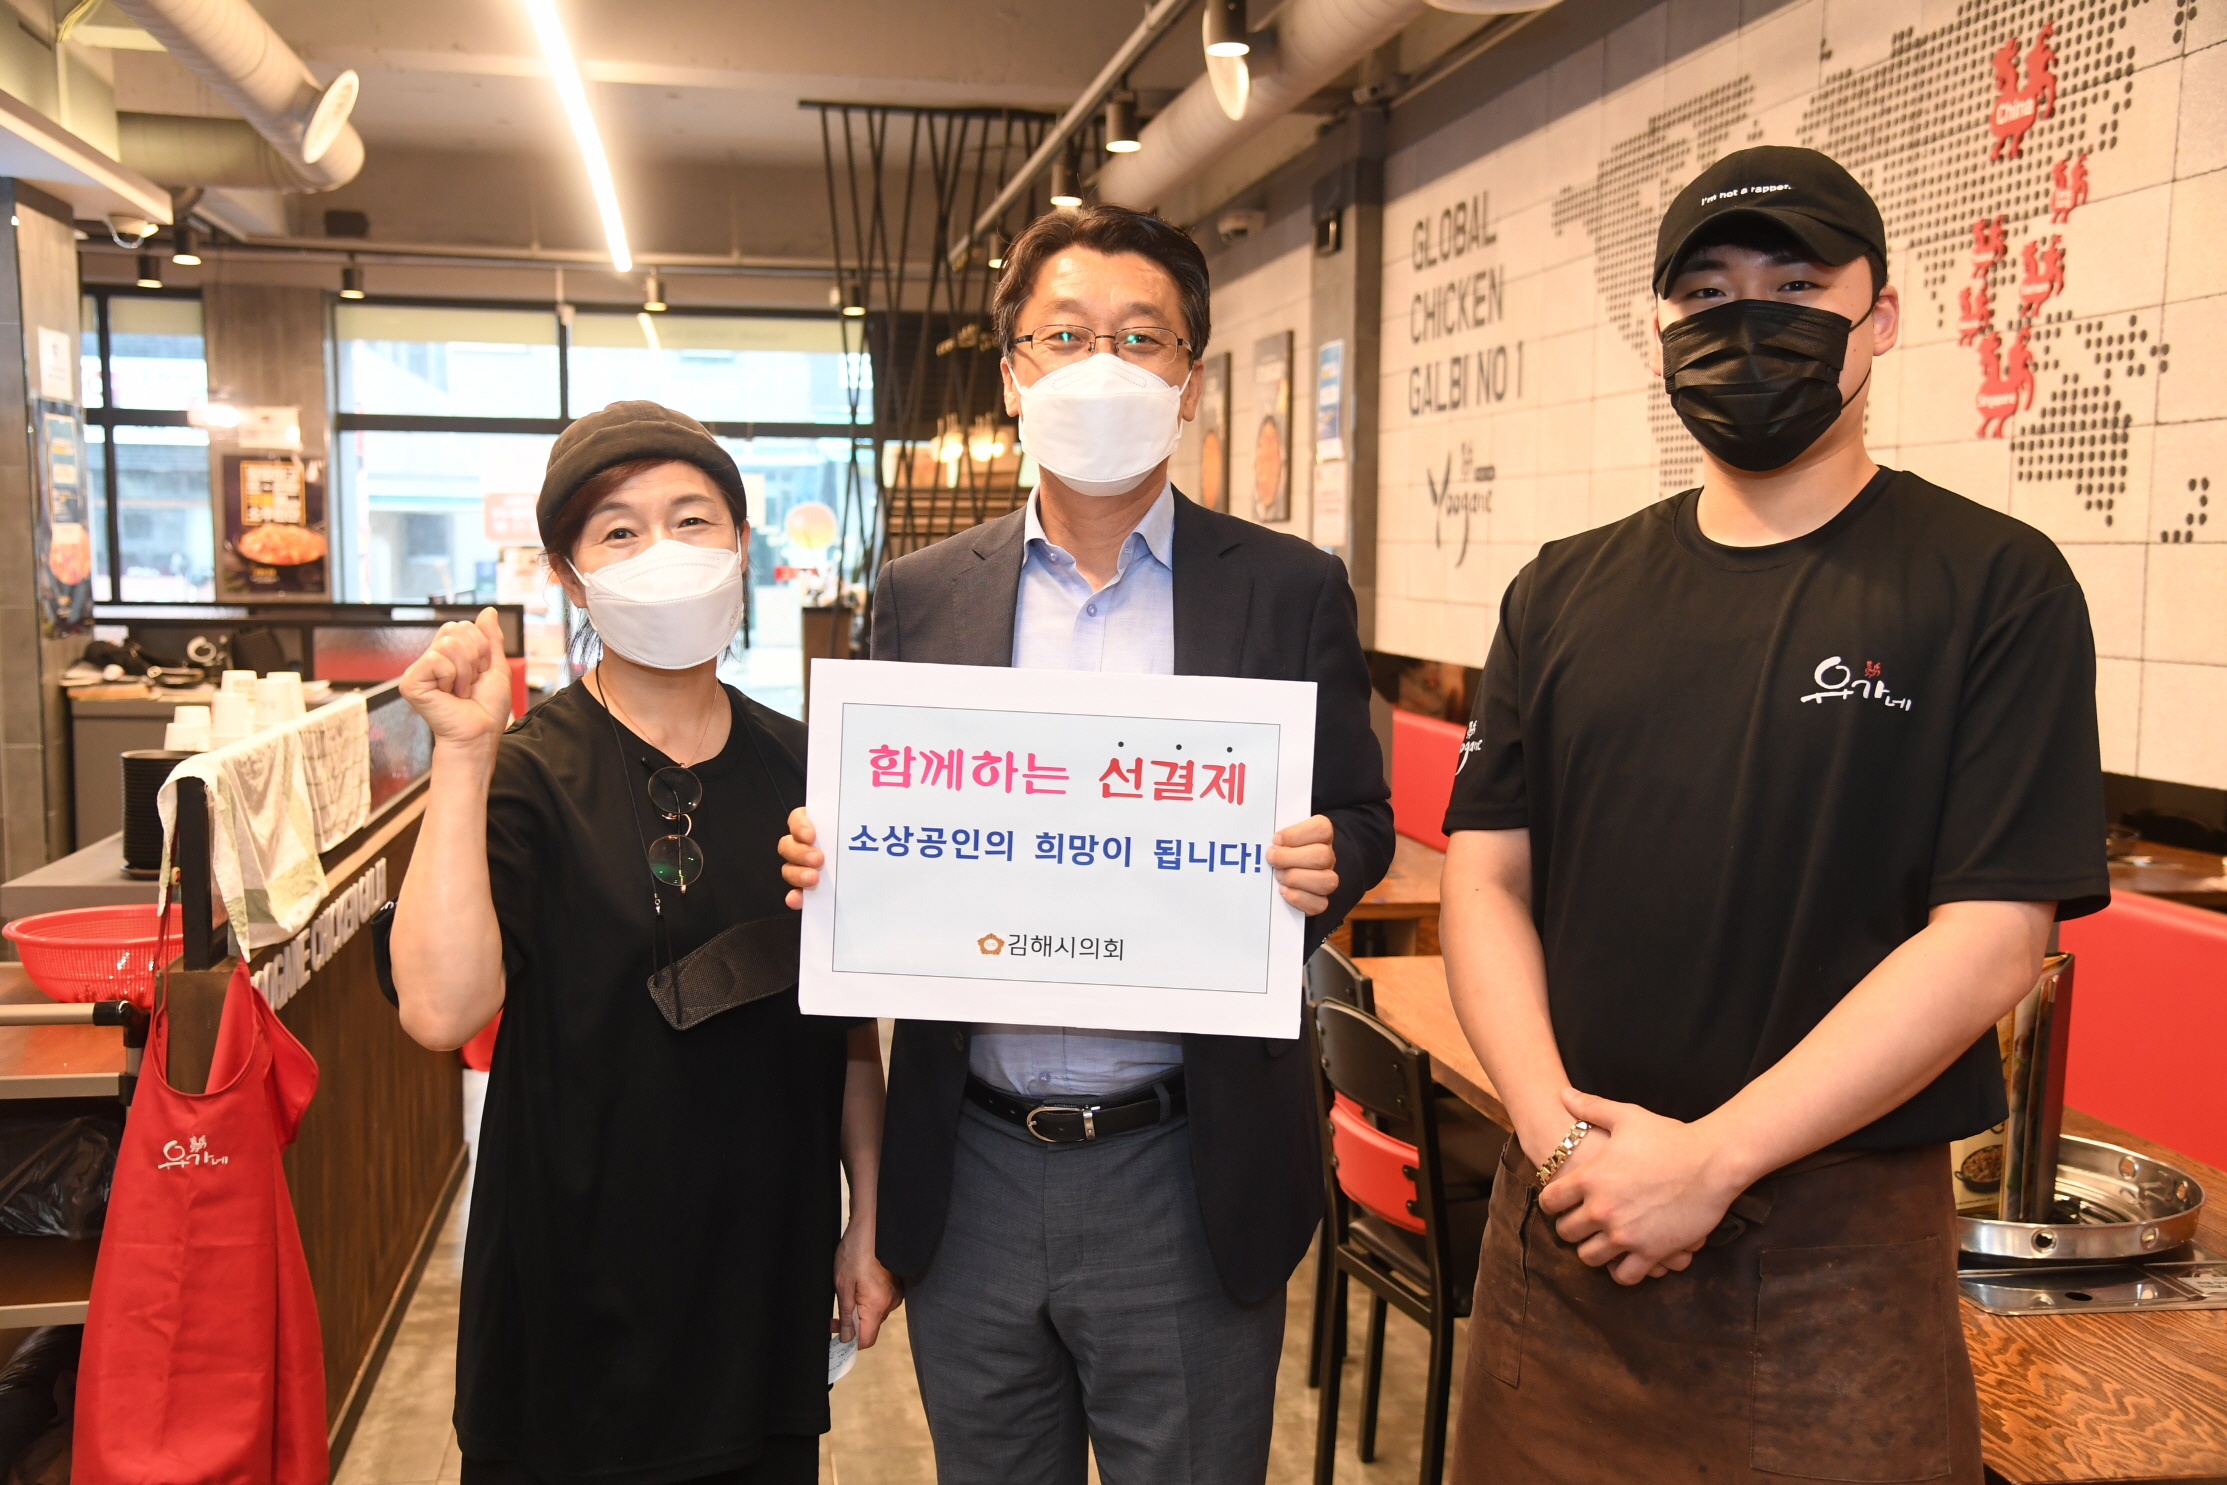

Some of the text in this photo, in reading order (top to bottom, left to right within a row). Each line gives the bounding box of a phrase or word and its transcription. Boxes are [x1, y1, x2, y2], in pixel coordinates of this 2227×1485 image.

[1995, 97, 2035, 125] China
[1701, 194, 1718, 206] I'm
[1719, 189, 1738, 199] not
[1740, 187, 1748, 195] a
[1412, 190, 1498, 272] GLOBAL
[1410, 265, 1504, 344] CHICKEN
[1409, 353, 1468, 416] GALBI
[1476, 345, 1507, 406] NO
[1516, 339, 1524, 398] 1
[1800, 655, 1912, 711] 유가네
[868, 743, 1247, 806] 함께하는 선결제
[848, 824, 1262, 874] 소상공인의 희망이 됩니다!
[1007, 933, 1125, 962] 김해시의회
[157, 1139, 229, 1171] 유가네
